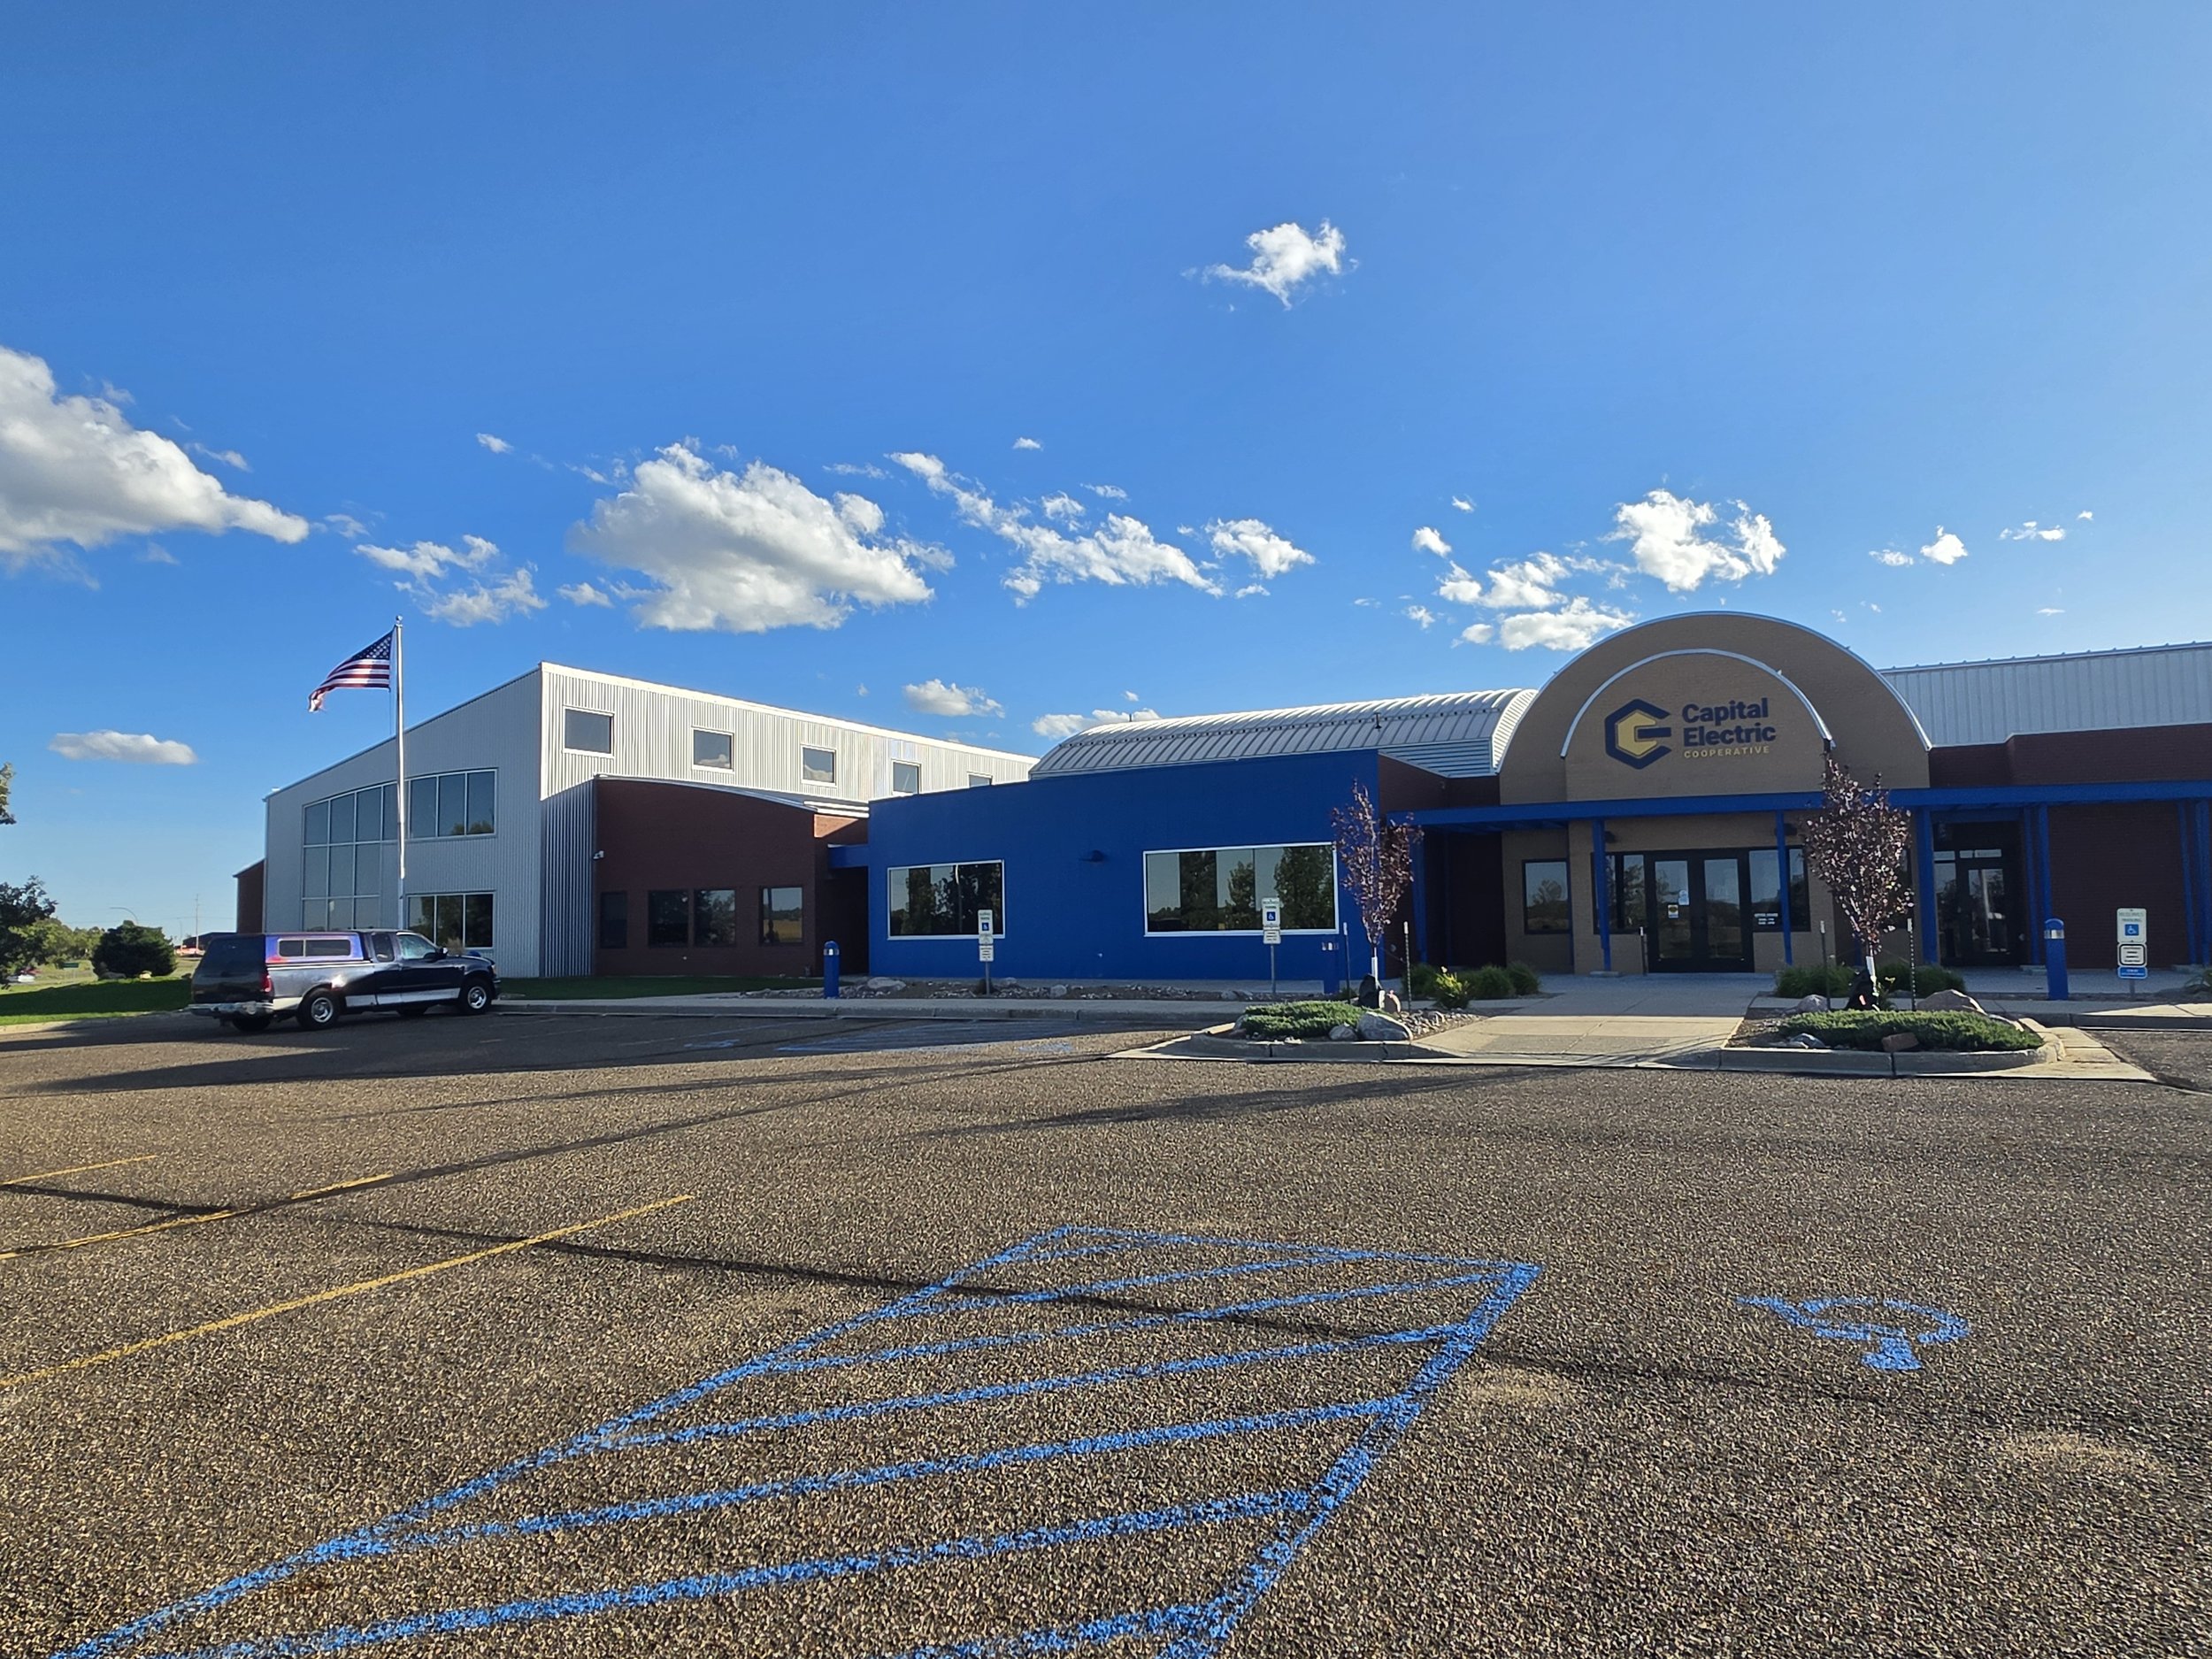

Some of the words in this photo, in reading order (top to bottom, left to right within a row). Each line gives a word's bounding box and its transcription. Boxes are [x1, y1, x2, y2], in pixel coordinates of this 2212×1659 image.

[1682, 698, 1769, 726] Capital
[1683, 723, 1777, 748] Electric
[1684, 746, 1770, 758] COOPERATIVE
